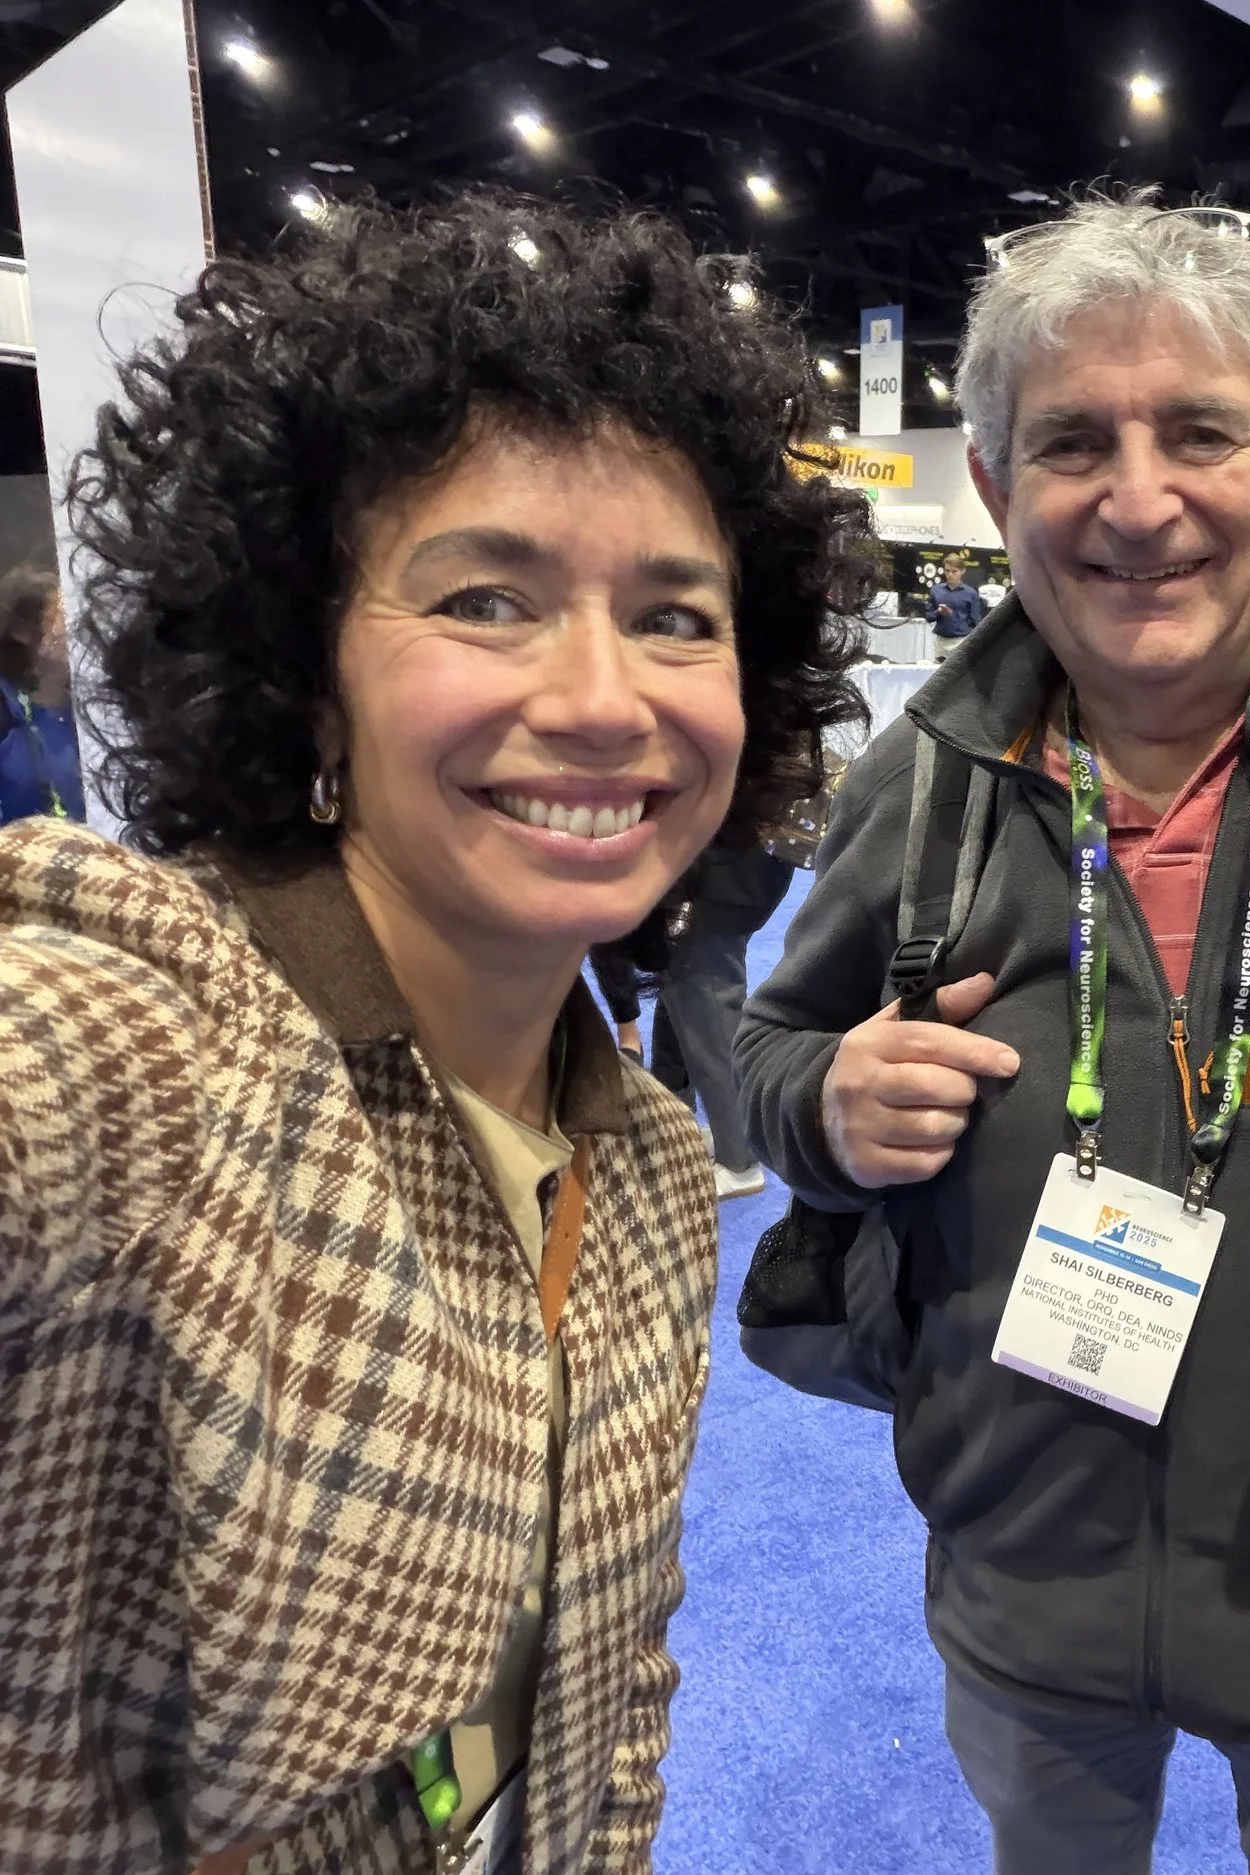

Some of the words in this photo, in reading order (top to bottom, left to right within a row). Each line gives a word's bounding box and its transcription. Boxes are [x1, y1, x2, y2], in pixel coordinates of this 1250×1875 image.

[864, 377, 898, 396] 1400
[1077, 848, 1095, 915] Society
[1080, 915, 1094, 945] for
[1080, 949, 1094, 1074] Neuroscience
[1228, 1015, 1245, 1042] for
[1219, 1047, 1243, 1115] Society
[1128, 1230, 1158, 1248] 2025
[1132, 1224, 1174, 1243] NEUROSCIENCE
[1050, 1252, 1083, 1273] SHAI
[1085, 1265, 1174, 1307] SILBERBERG
[1023, 1274, 1083, 1307] DIRECTOR,
[1118, 1310, 1143, 1330] DEA,
[1146, 1322, 1183, 1343] NINDS
[1093, 1288, 1119, 1305] PHD
[1021, 1287, 1066, 1311] NATIONAL
[1068, 1305, 1121, 1332] INSTITUTES
[1123, 1326, 1138, 1337] OF
[1138, 1331, 1176, 1353] HEALTH
[1123, 1339, 1140, 1352] DC
[1048, 1371, 1108, 1405] EXHIBITOR
